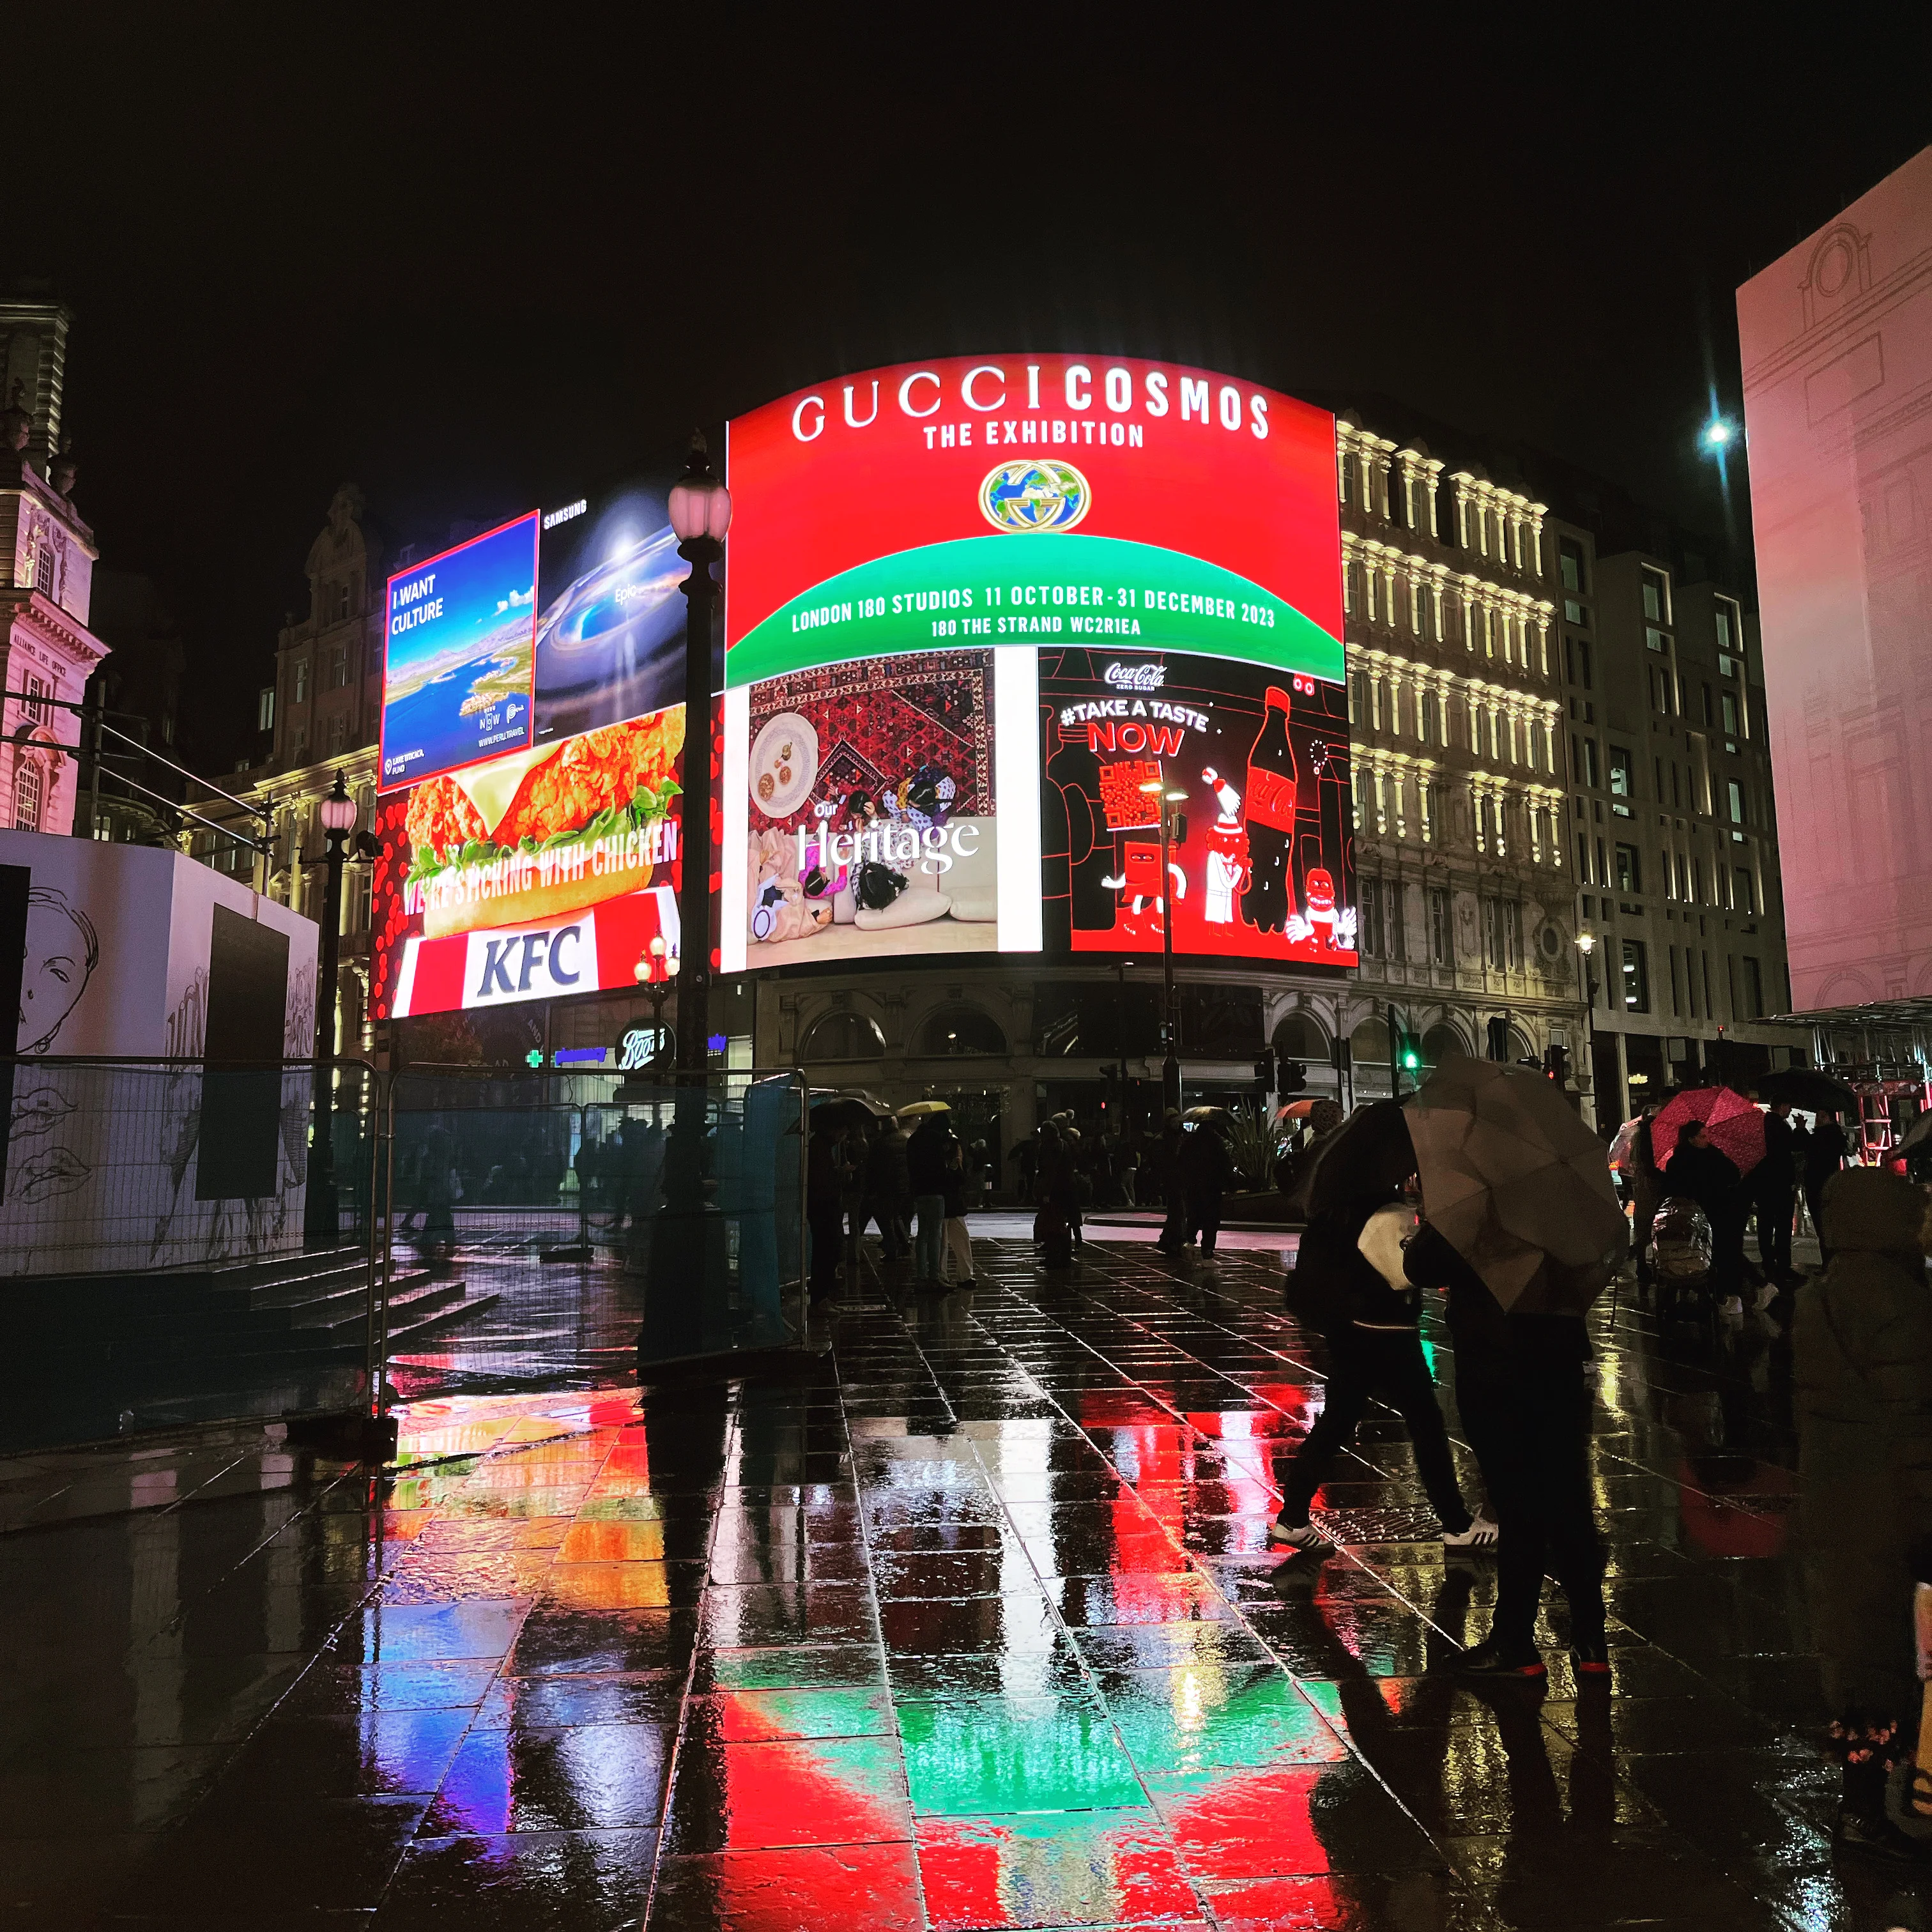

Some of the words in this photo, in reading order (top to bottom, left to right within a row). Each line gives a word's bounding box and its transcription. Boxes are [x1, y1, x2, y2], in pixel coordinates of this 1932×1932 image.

[792, 365, 1041, 443] GUCCI
[1064, 364, 1269, 440] COSMOS
[923, 423, 972, 449] THE
[986, 419, 1144, 448] EXHIBITION
[544, 498, 587, 530] SAMSUNG
[393, 591, 397, 610] I
[400, 574, 436, 606] WANT
[615, 583, 637, 606] Epic
[792, 602, 852, 632] LONDON
[857, 597, 885, 619] 180
[892, 587, 974, 614] STUDIOS
[985, 586, 1001, 606] 11
[1144, 589, 1236, 620] DECEMBER
[1241, 603, 1275, 629] 2023
[392, 597, 443, 635] CULTURE
[931, 619, 956, 638] 180
[961, 617, 992, 635] THE
[997, 616, 1062, 633] STRAND
[1060, 699, 1130, 727] #TAKE
[1131, 699, 1148, 717] A
[1149, 701, 1209, 733] TASTE
[1087, 721, 1186, 758] NOW
[814, 801, 839, 818] Our
[455, 855, 533, 905] STICKING
[539, 842, 585, 888] WITH
[592, 821, 678, 877] CHICKEN
[797, 819, 980, 875] Heritage
[477, 924, 581, 998] KFC
